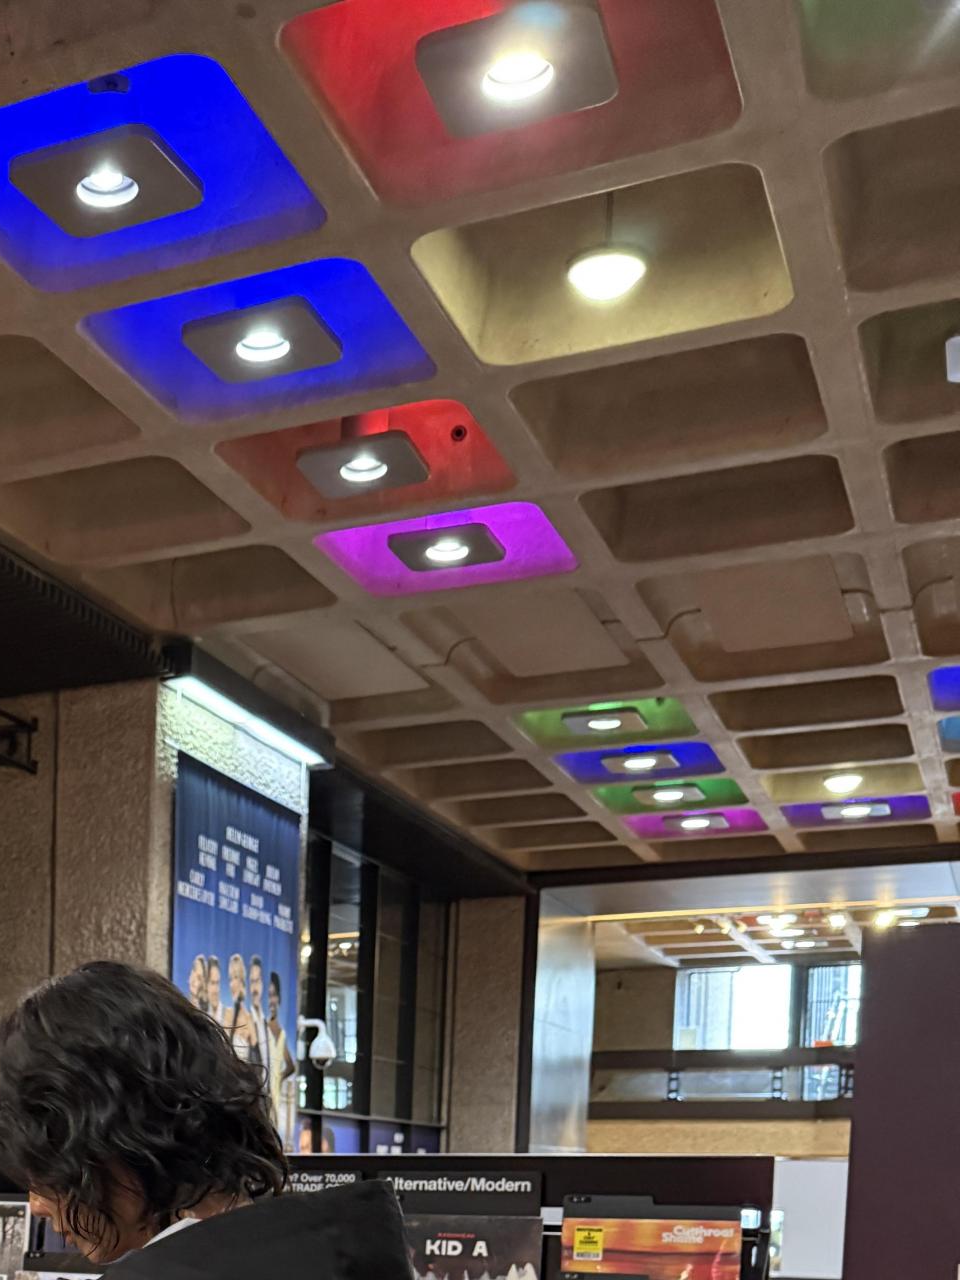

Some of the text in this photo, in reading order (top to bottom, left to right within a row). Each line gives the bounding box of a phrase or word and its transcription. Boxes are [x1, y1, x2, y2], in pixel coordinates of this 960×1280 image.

[386, 1176, 532, 1193] lternative/Modern
[425, 1239, 488, 1257] KID A
